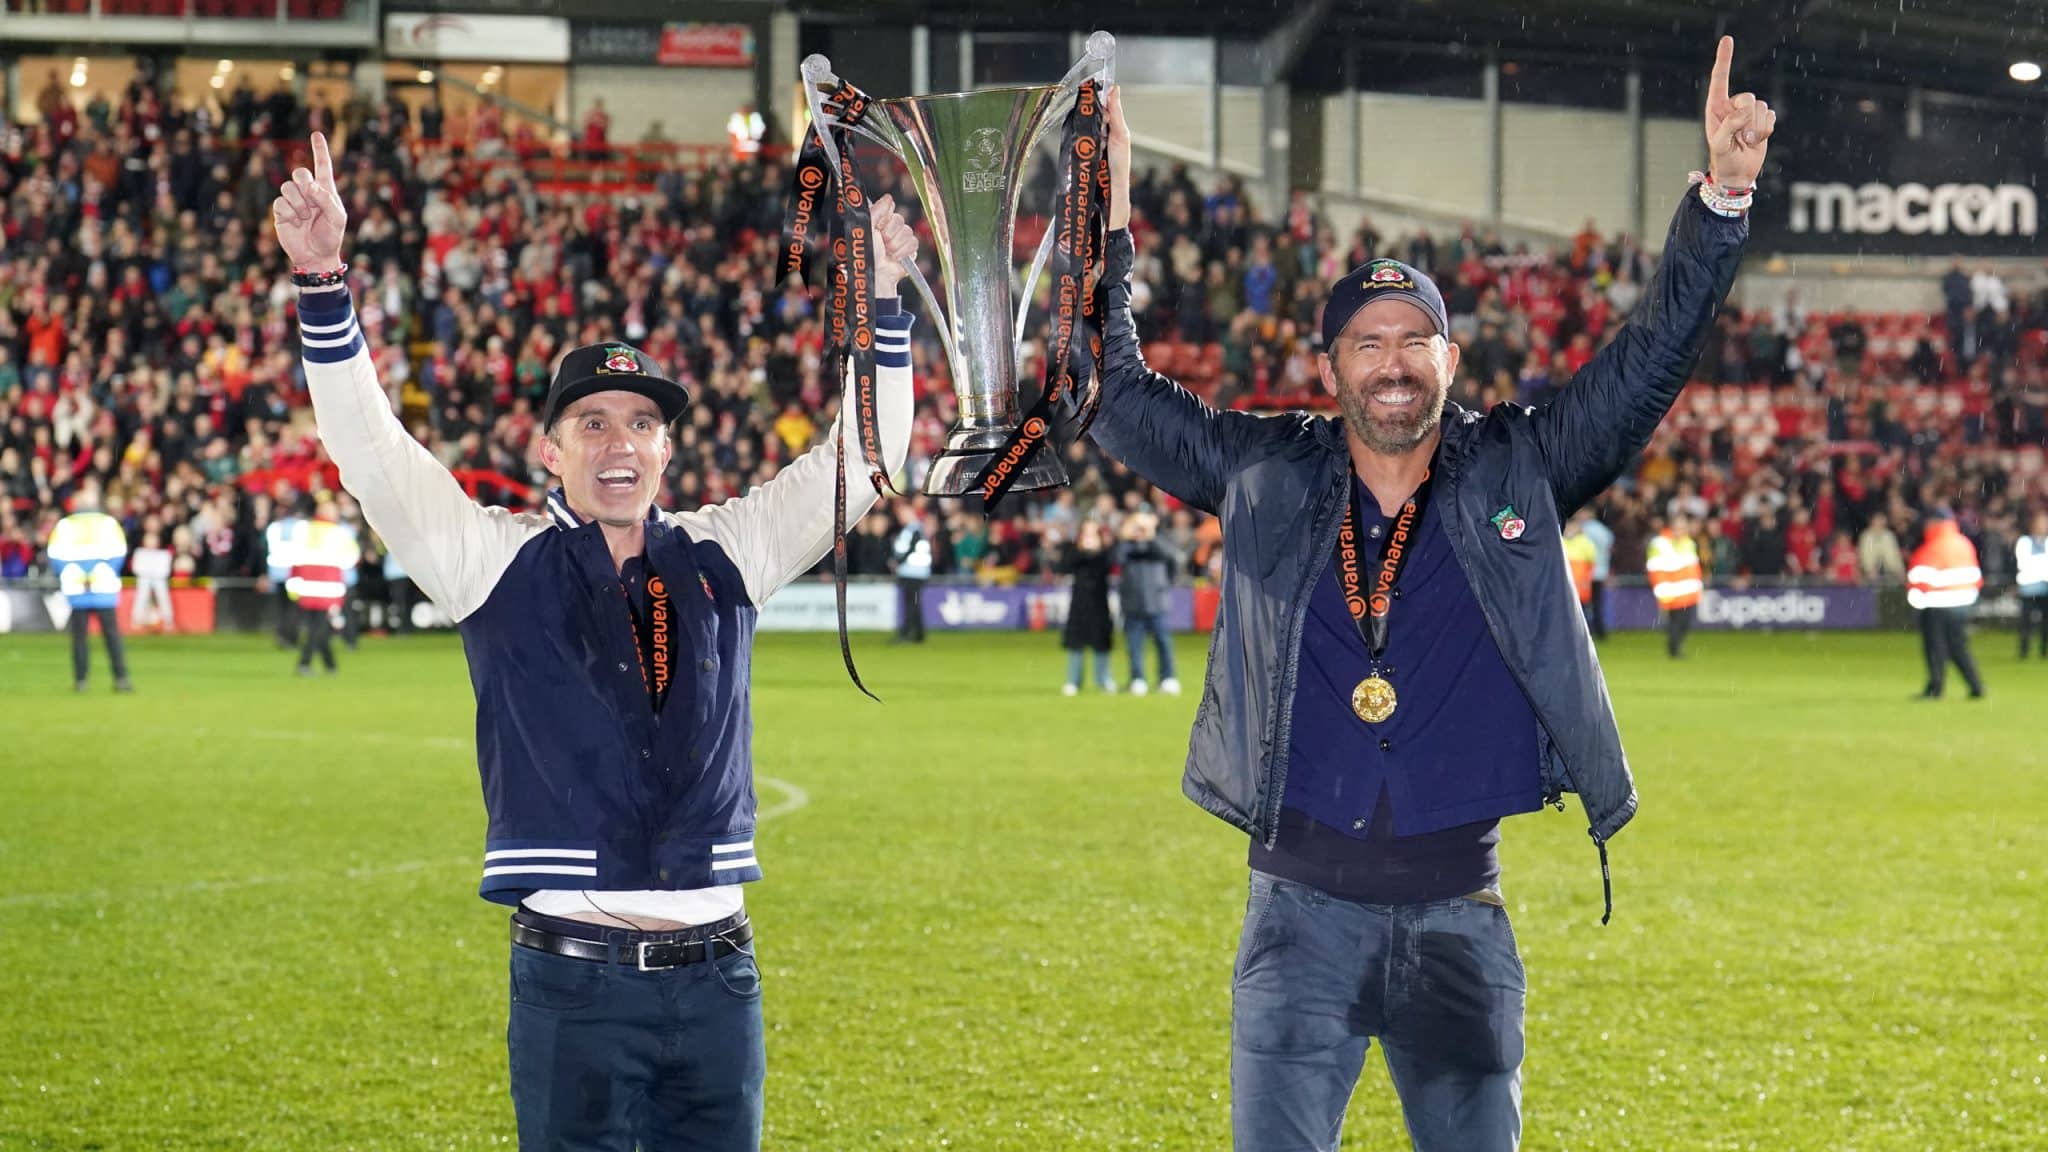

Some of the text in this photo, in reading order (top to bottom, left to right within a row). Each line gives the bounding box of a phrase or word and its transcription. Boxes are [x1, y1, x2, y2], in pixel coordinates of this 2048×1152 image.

[963, 180, 1006, 191] LEAGUE
[1075, 161, 1091, 257] vanarama
[1789, 182, 2038, 236] macron
[852, 227, 869, 325] vanarama
[861, 375, 880, 469] vanarama
[1376, 503, 1416, 593] vanarama
[1697, 590, 1825, 627] Expedia
